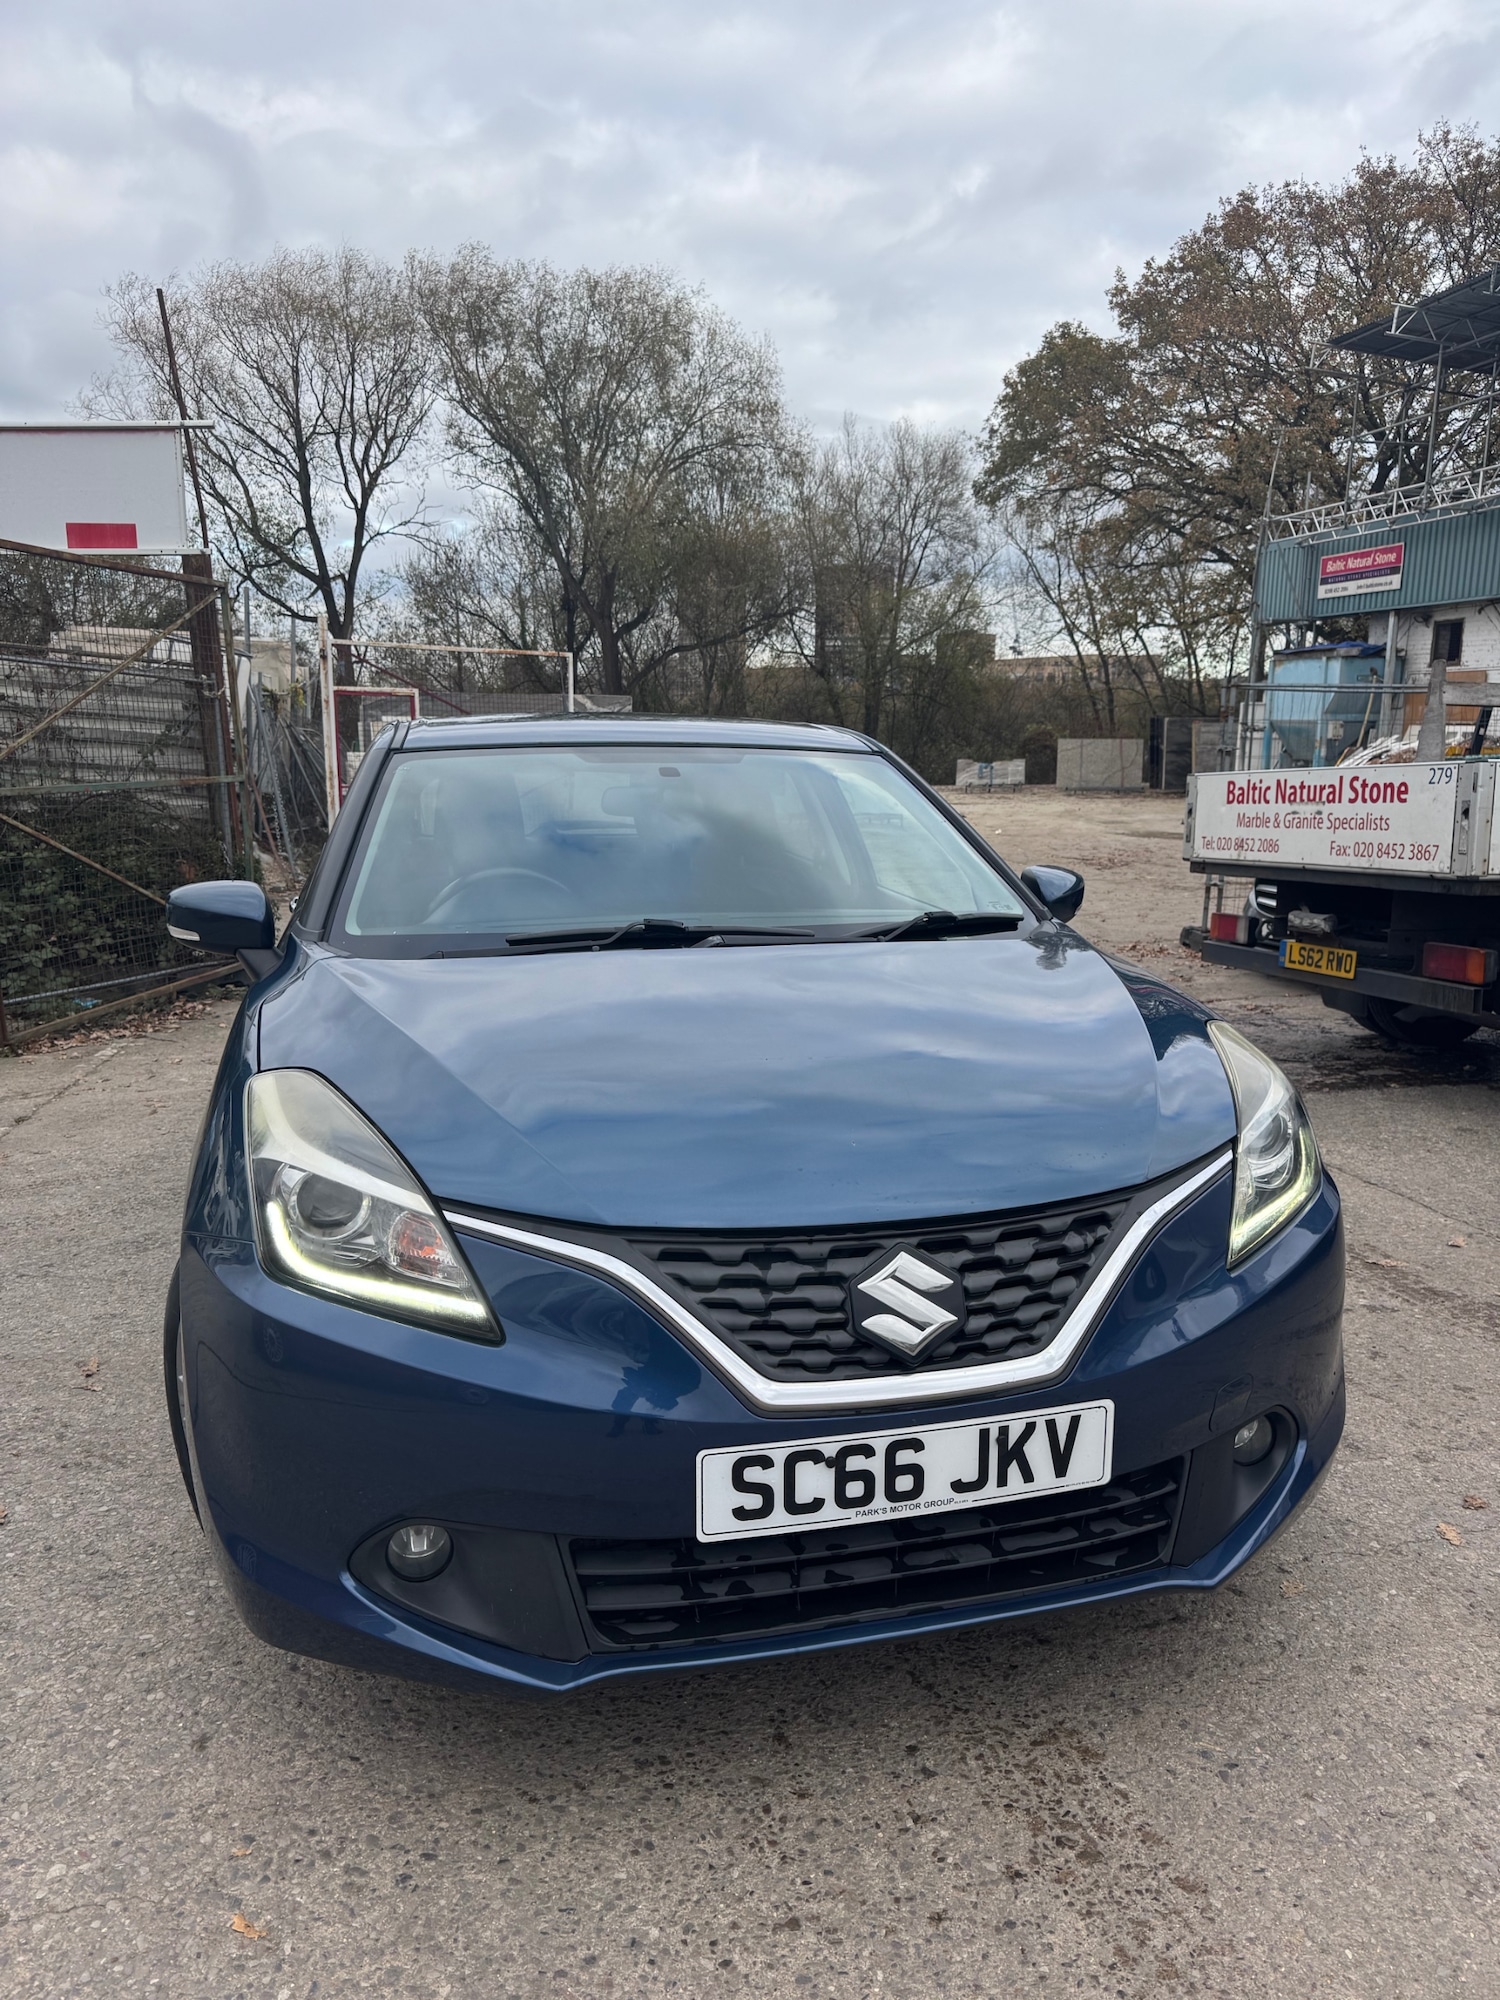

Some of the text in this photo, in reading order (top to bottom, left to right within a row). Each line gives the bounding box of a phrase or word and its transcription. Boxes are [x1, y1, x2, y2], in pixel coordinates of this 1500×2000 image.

[1326, 552, 1397, 573] Baltic Natural Stone
[1428, 766, 1453, 785] 279
[1226, 775, 1409, 805] Baltic Natural Stone
[1236, 811, 1390, 835] Marble & Granite Specialists
[1201, 835, 1280, 854] Tel: 020 8452 2086
[1329, 840, 1440, 861] Fax: 020 8452 3867
[1287, 944, 1354, 974] LS62 RWO
[731, 1414, 1082, 1522] SC66 JKV
[855, 1507, 888, 1518] PARK'S
[889, 1502, 922, 1513] MOTOR
[923, 1497, 955, 1509] GROUP
